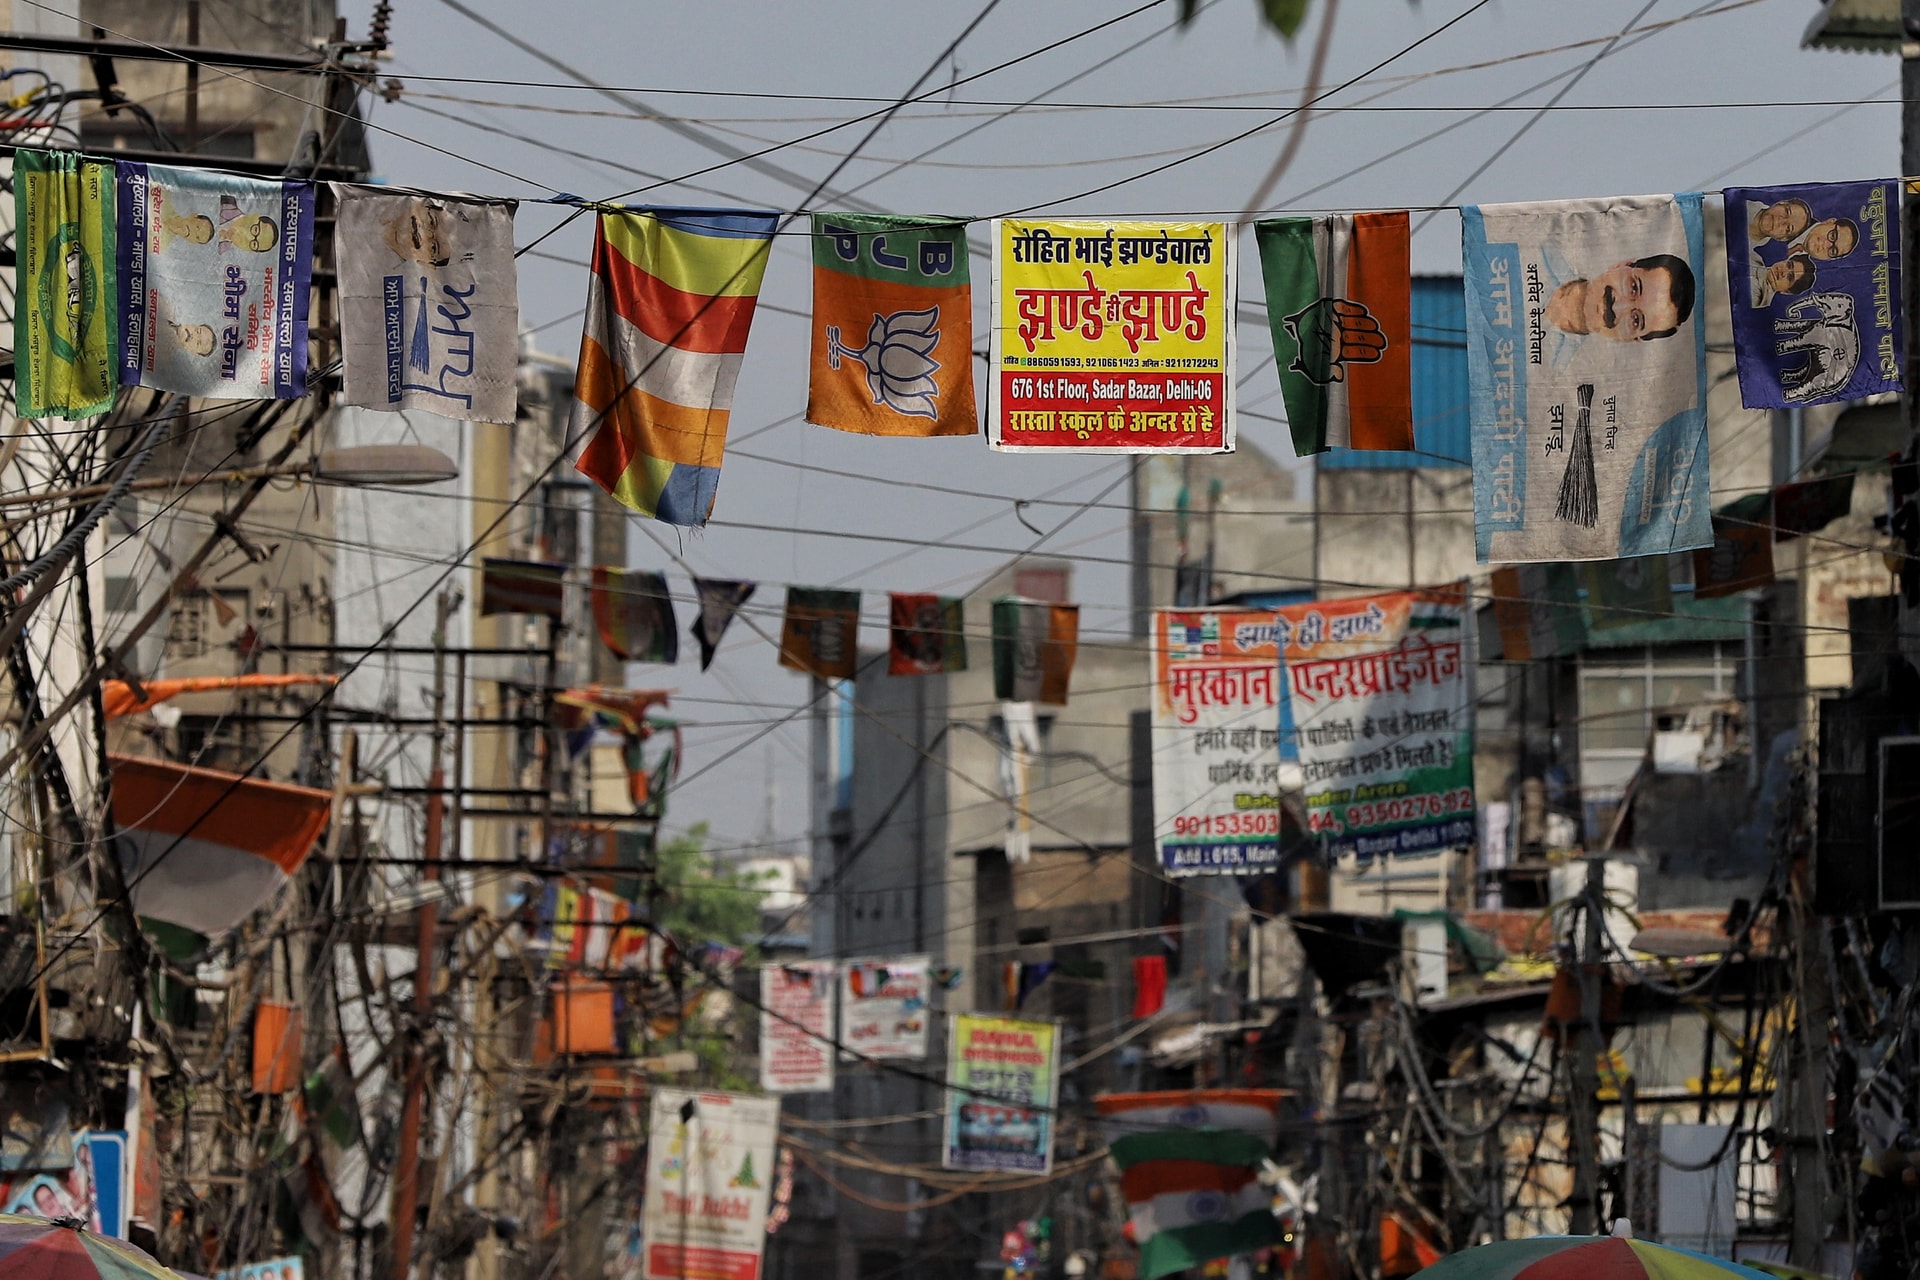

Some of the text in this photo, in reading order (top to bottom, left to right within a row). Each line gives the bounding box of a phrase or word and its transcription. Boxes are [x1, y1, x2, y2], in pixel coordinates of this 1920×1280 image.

[127, 174, 145, 227] मुख्यालय
[1860, 186, 1889, 258] बहुजन
[286, 196, 302, 262] संस्थापक
[1012, 229, 1213, 267] रोहित भाई झण्डेवाले
[280, 280, 295, 347] सनाउल्ला
[1015, 270, 1210, 354] झण्डे ही झण्डे
[1526, 263, 1546, 365] अरविंद केजरीवाल
[1872, 261, 1892, 330] समाज
[221, 265, 247, 381] भीम सेना
[247, 303, 257, 351] समिति
[260, 267, 275, 385] भारतीय भीम सेवा
[146, 345, 155, 372] खान
[279, 352, 293, 386] खान
[1086, 358, 1139, 368] 9210661423
[1165, 359, 1219, 368] 9211272243
[1011, 378, 1212, 404] 676 1st Floor, Sadar Bazar, Delhi-06
[1488, 256, 1523, 523] आम आदमी पार्टी
[1603, 395, 1617, 422] चुनाव
[1009, 405, 1214, 440] रास्ता स्कूल के अन्दर से है
[1545, 404, 1566, 458] झाड़ू
